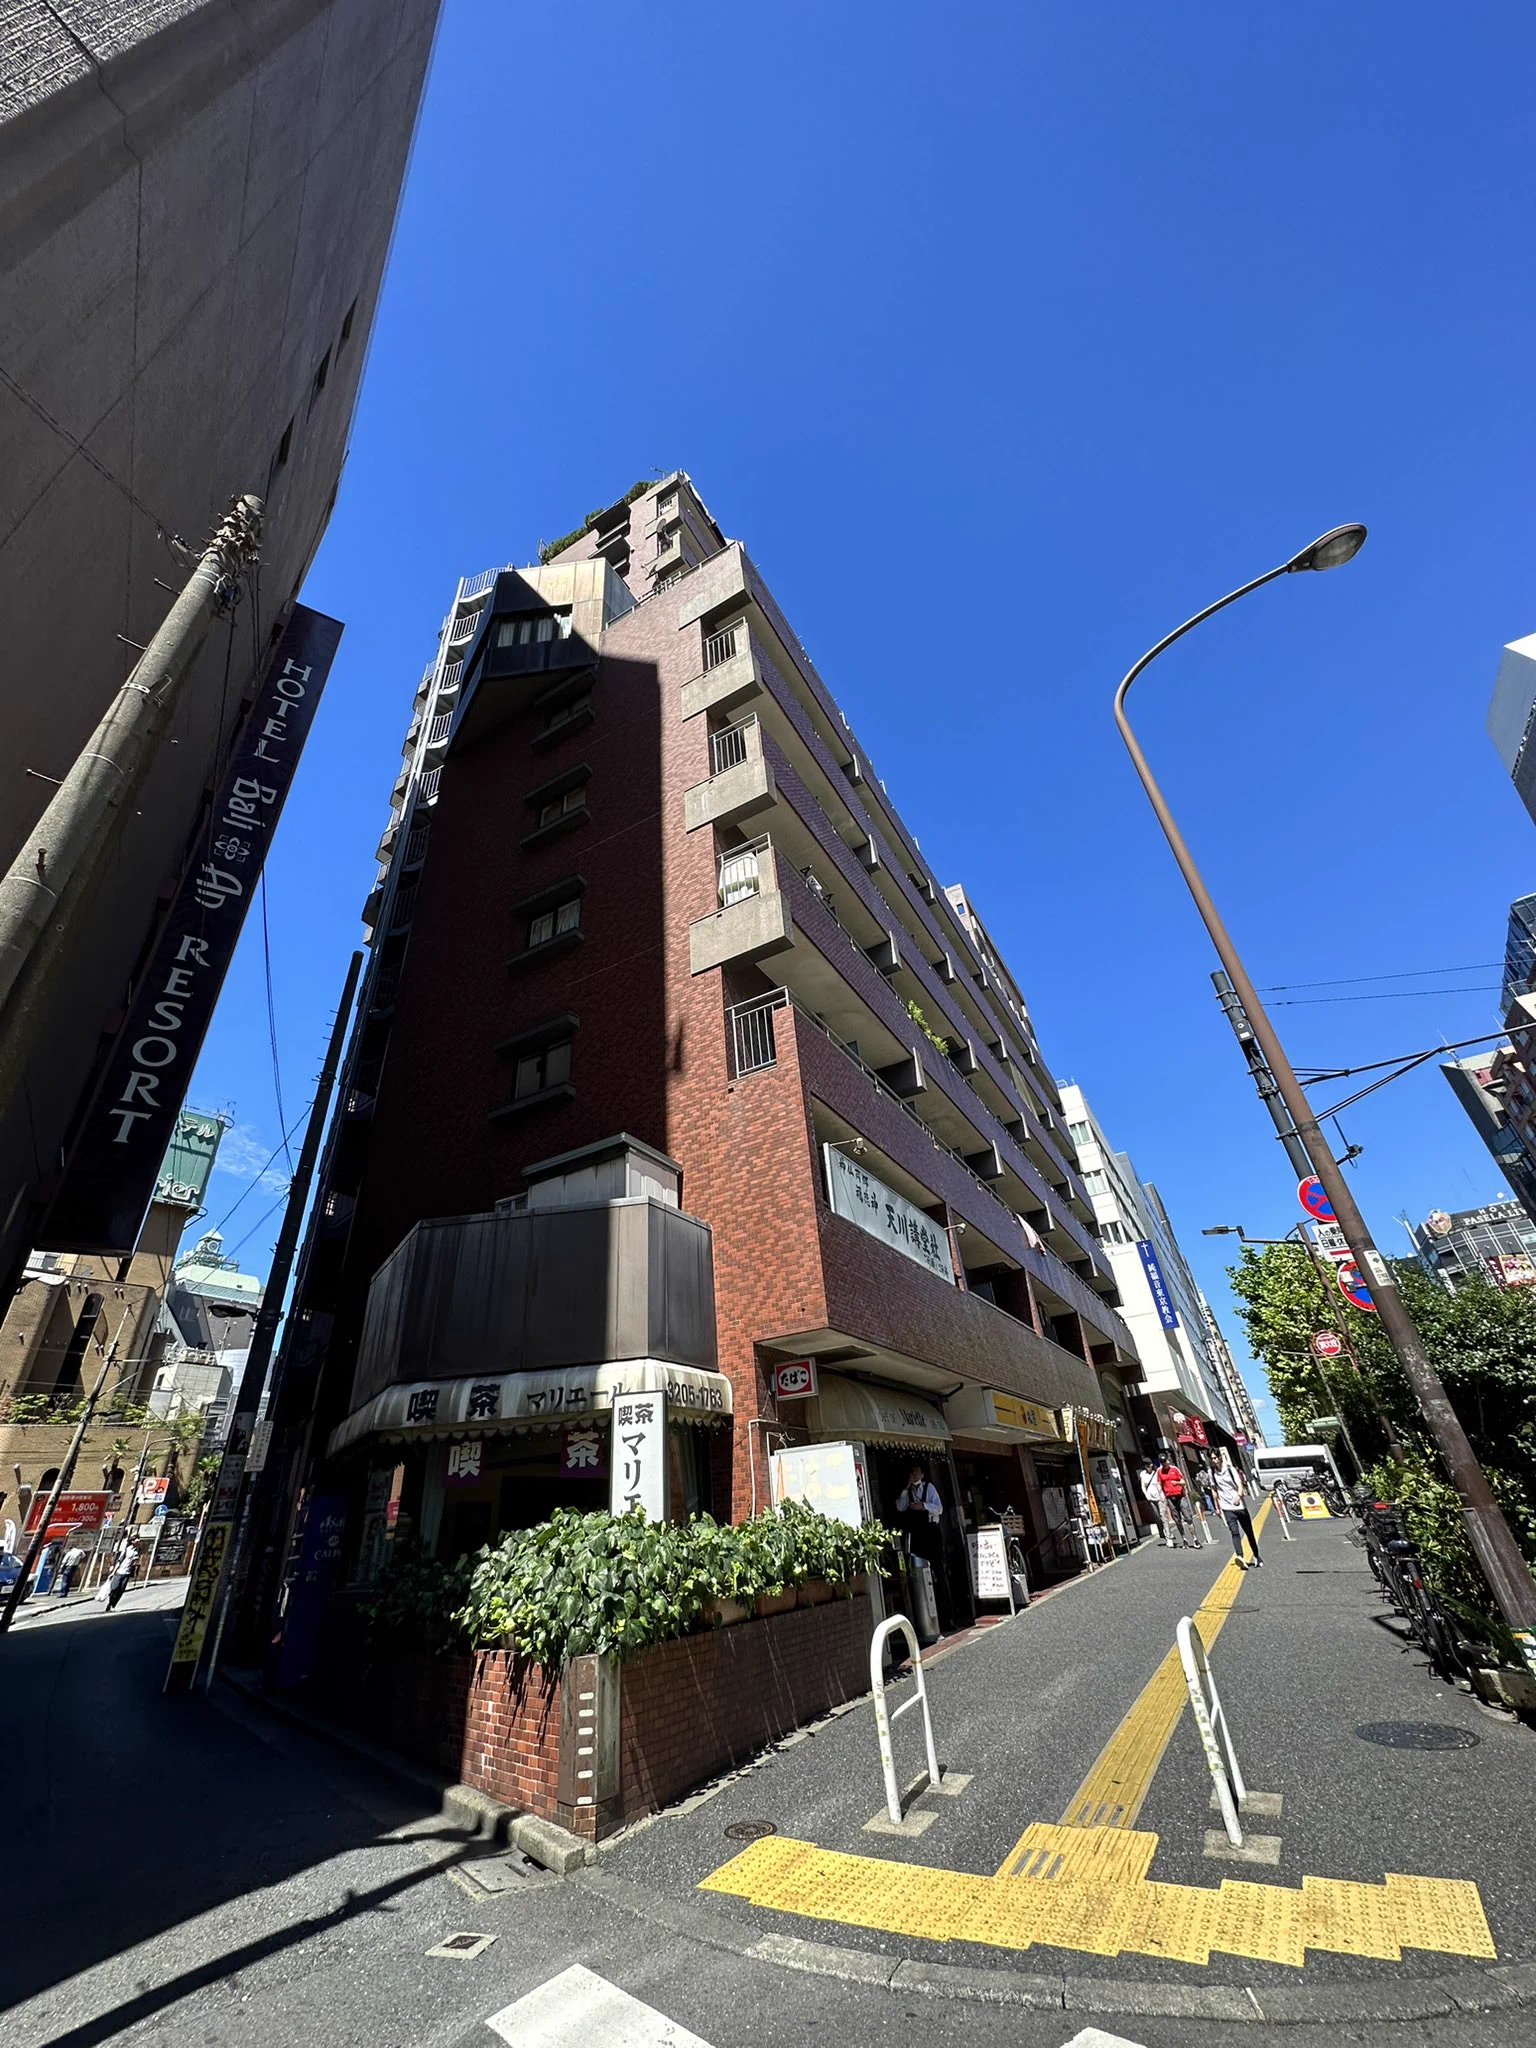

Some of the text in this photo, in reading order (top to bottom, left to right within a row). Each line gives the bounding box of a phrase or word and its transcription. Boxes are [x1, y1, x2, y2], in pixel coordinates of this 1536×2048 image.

[253, 658, 313, 764] HOTEL
[109, 934, 211, 1144] RESORT
[1463, 1211, 1505, 1226] PASELA
[780, 1369, 807, 1387] たばこ
[667, 1381, 723, 1408] 3205-1763
[618, 1402, 654, 1426] 喫茶
[447, 1441, 482, 1478] 喫
[566, 1431, 600, 1469] 茶
